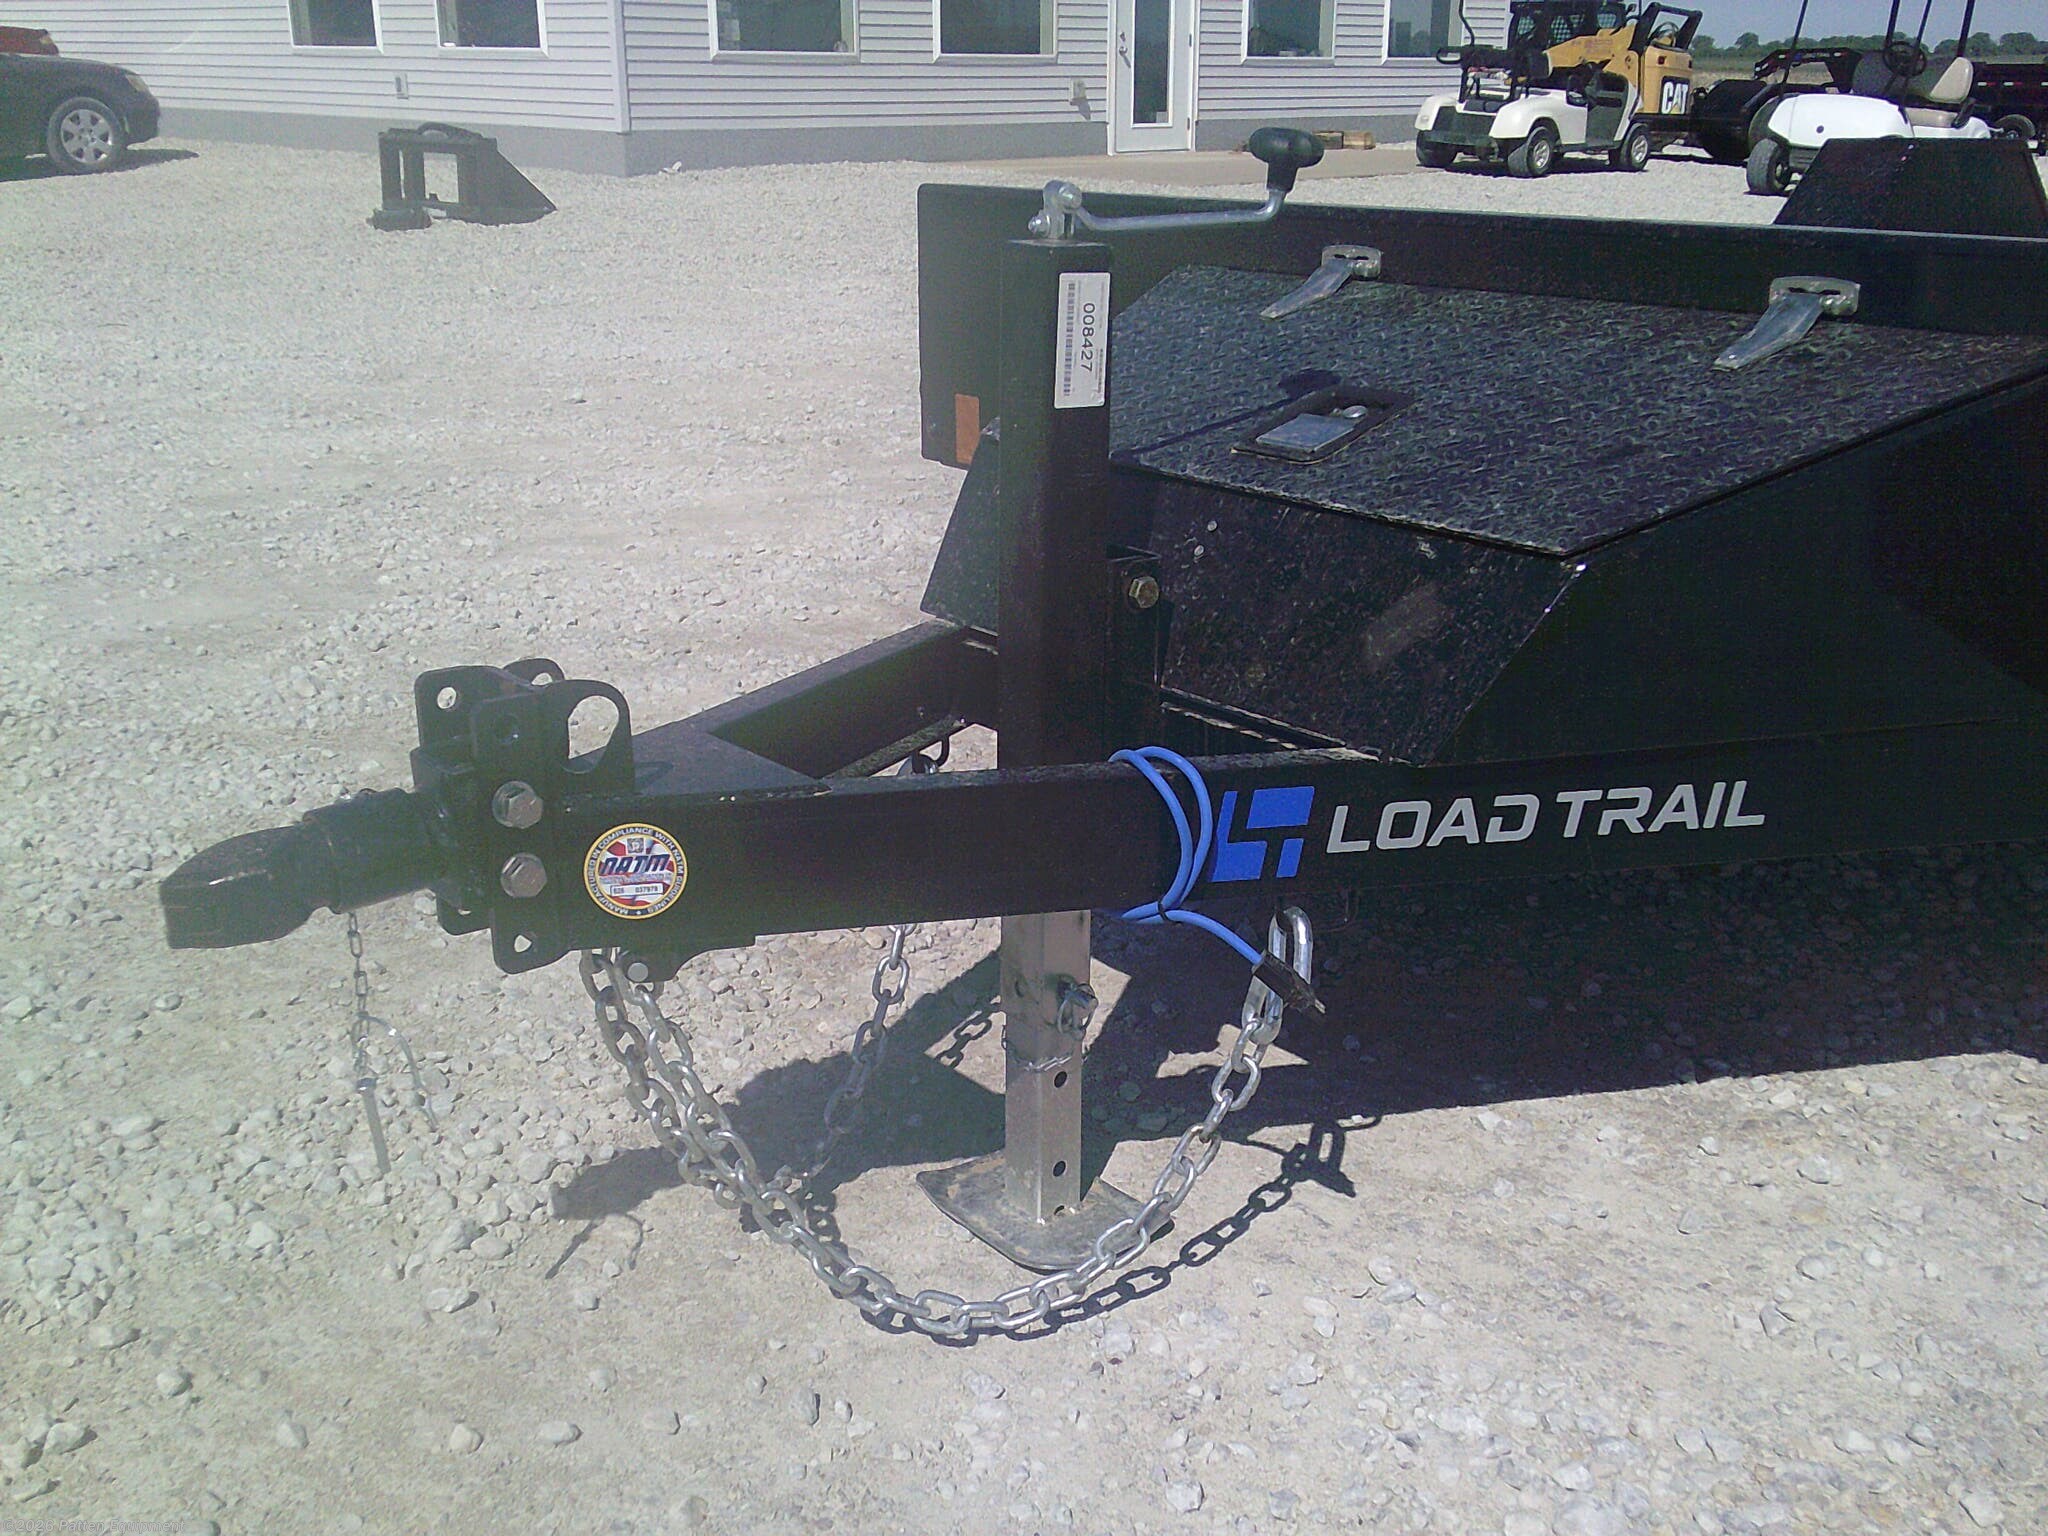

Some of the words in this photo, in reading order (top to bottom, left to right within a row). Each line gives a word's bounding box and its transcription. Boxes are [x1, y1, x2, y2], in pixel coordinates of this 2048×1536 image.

[1661, 81, 1689, 115] CAT
[1081, 302, 1096, 373] 008427
[1326, 793, 1541, 854] LOAD
[1556, 780, 1766, 839] TRAIL
[598, 827, 654, 850] COMPLIANCE
[654, 831, 674, 850] WITH
[672, 849, 684, 874] NATM
[599, 853, 671, 875] NATM
